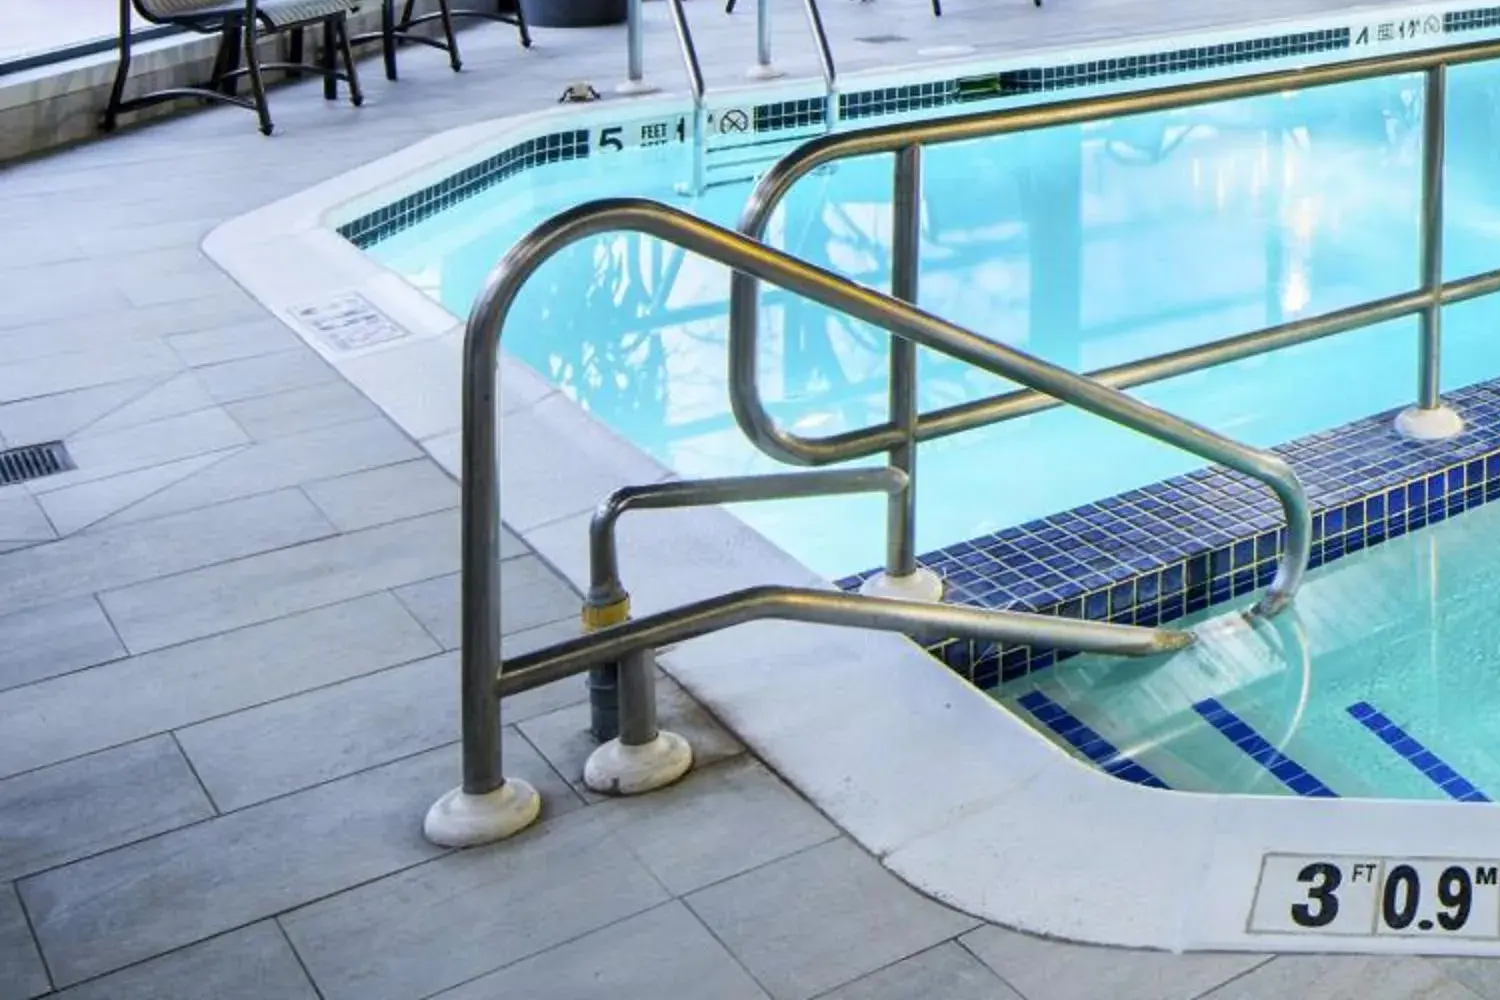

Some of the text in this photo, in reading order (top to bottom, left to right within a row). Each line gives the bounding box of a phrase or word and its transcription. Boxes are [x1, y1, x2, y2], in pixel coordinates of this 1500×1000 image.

[1291, 862, 1498, 931] 3 FT 0.9 M
